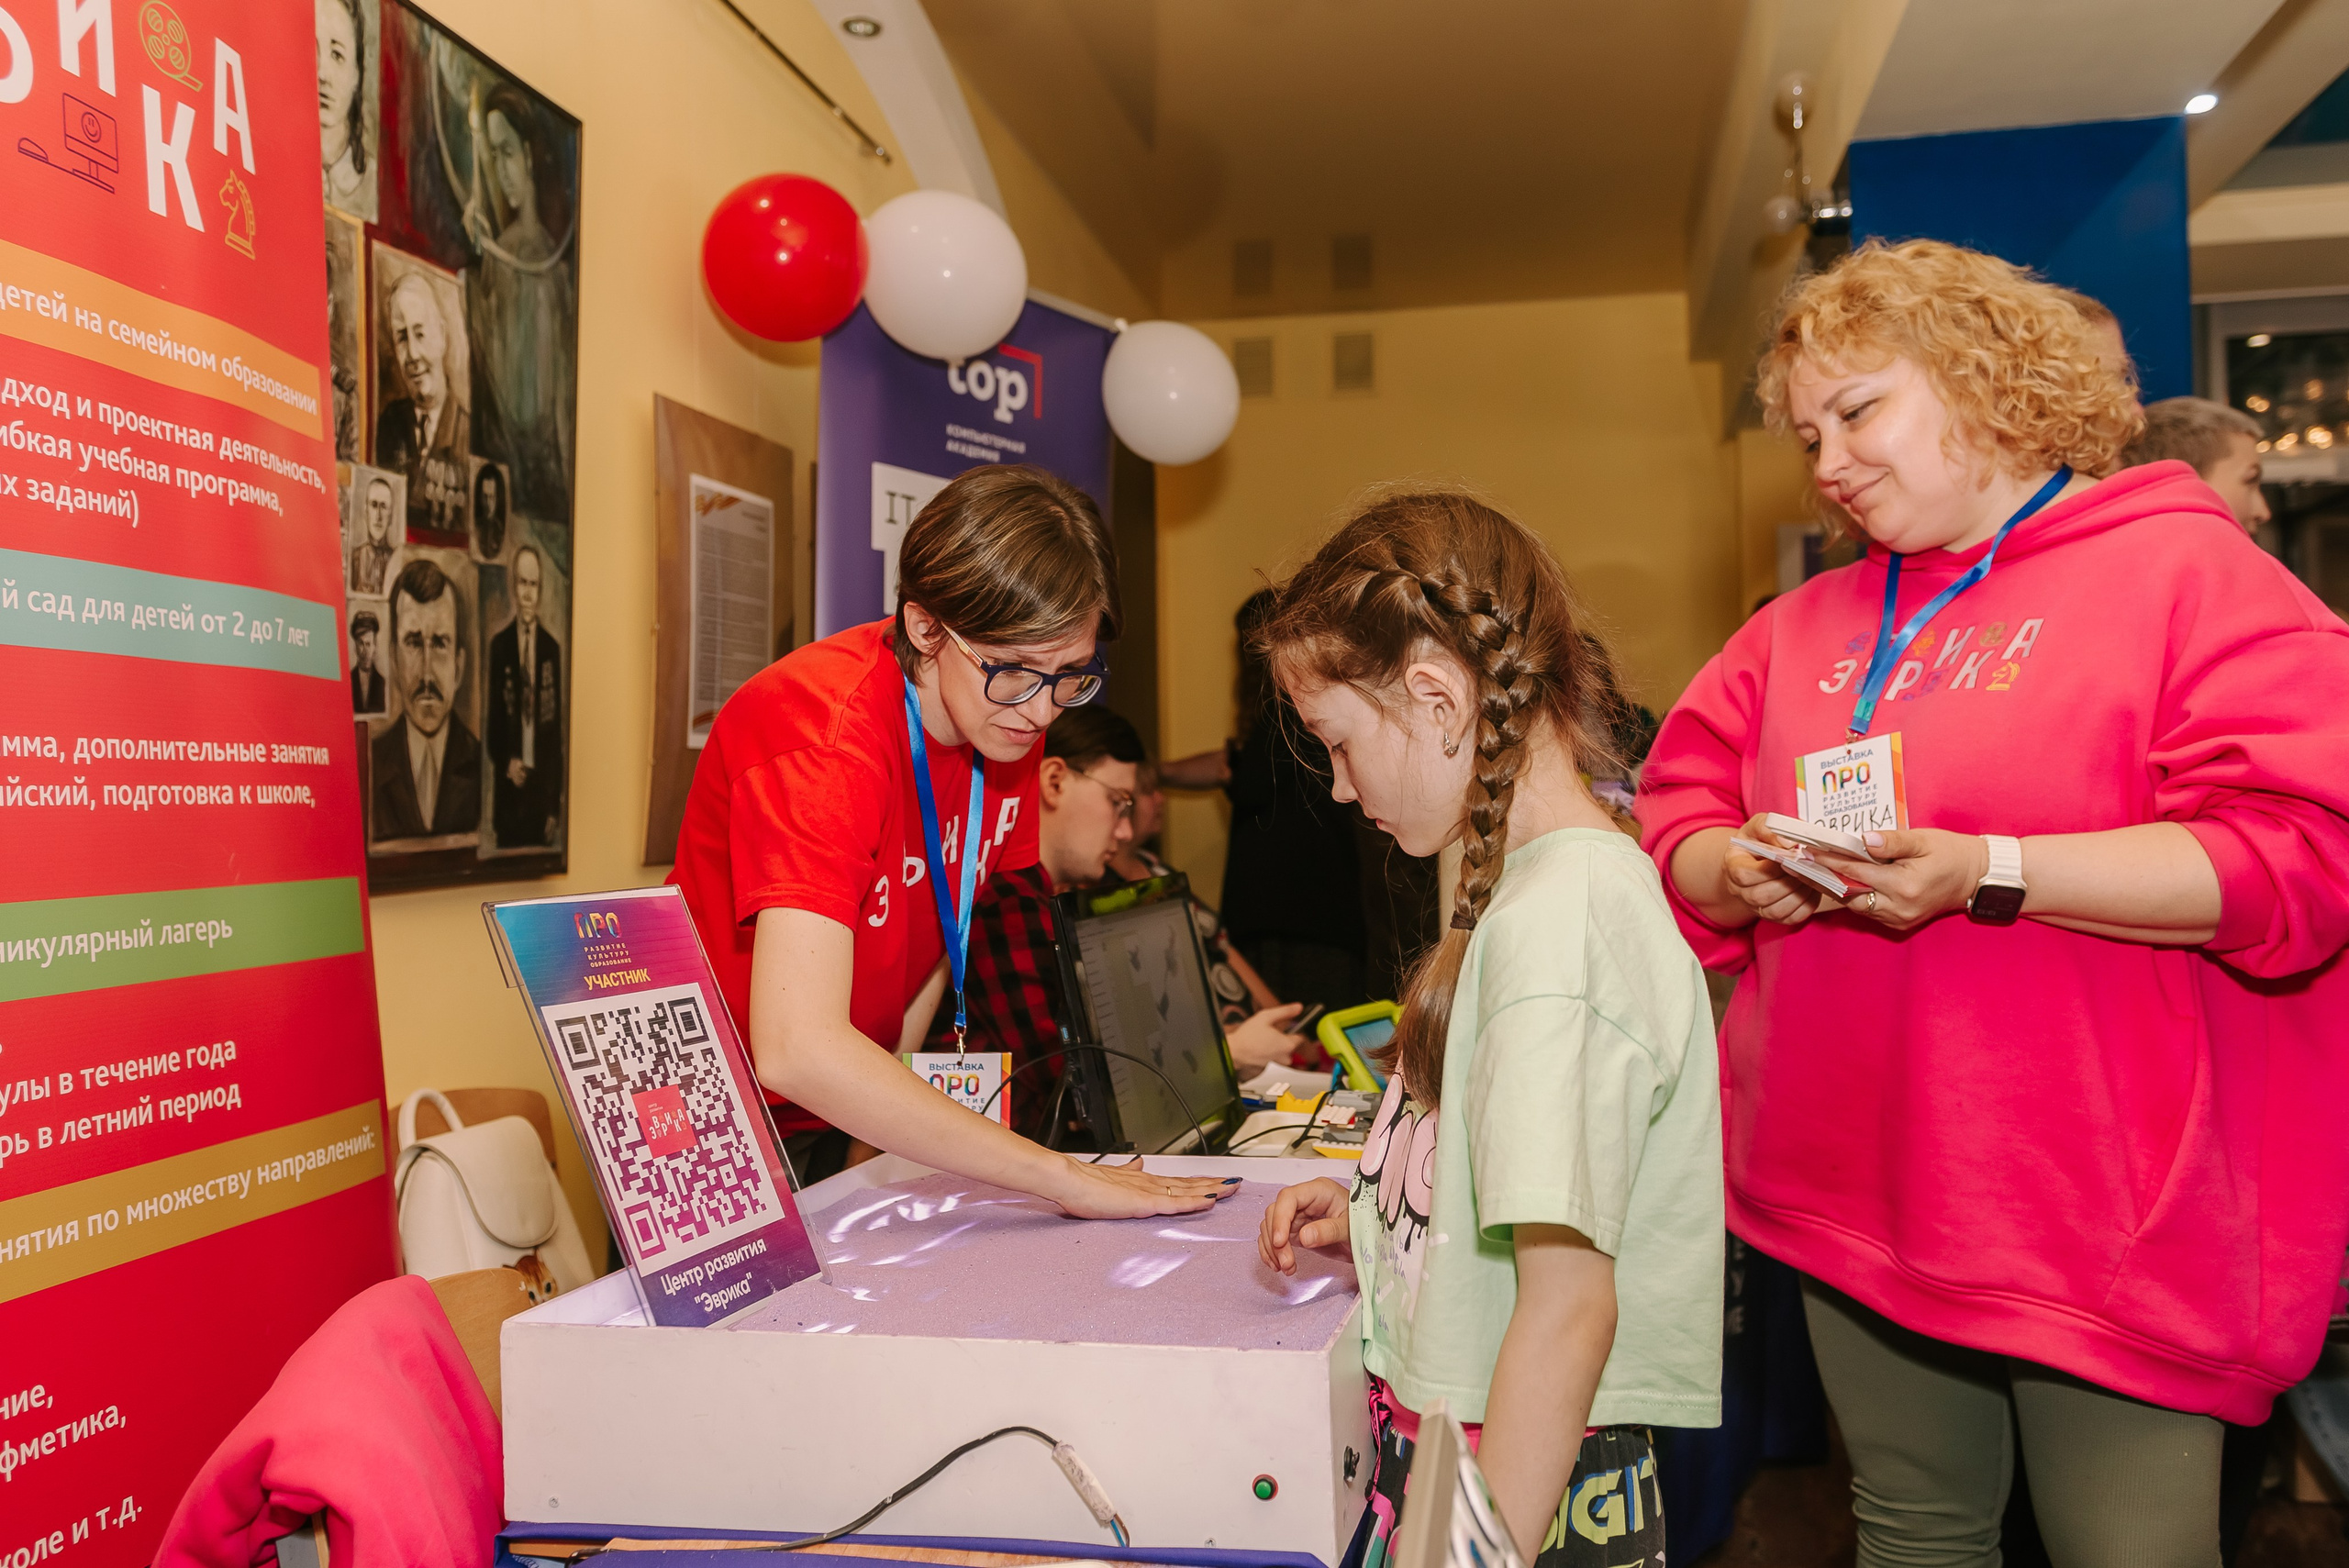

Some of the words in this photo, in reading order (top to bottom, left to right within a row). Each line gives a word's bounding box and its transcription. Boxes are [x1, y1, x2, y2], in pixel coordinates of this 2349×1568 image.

[74, 306, 103, 335] на
[108, 328, 217, 373] семейном
[221, 356, 317, 416] образовании
[1, 377, 71, 420] дход
[77, 395, 92, 419] и
[98, 402, 215, 453] проектная
[218, 437, 327, 495] деятельность,
[26, 479, 139, 528] заданий)
[78, 442, 171, 484] учебная
[176, 467, 284, 517] программа,
[3, 578, 18, 609] й
[28, 590, 75, 622] сад
[82, 598, 126, 625] для
[132, 603, 195, 631] детей
[201, 614, 227, 634] от
[232, 611, 245, 637] 2
[250, 619, 273, 645] до
[275, 617, 284, 641] 7
[287, 627, 310, 647] лет
[1818, 618, 2044, 701] ЭРИКА
[73, 737, 266, 764] дополнительные
[271, 743, 329, 765] занятия
[1820, 749, 1874, 769] ВЫСТАВКА
[104, 784, 234, 812] подготовка
[239, 785, 252, 805] к
[256, 784, 316, 808] школе,
[1822, 762, 1871, 795] ПРО
[1822, 784, 1877, 803] РАЗВИТИЕ
[1823, 798, 1877, 817] ОБРАЗОВАНИЕ
[160, 919, 233, 949] лагерь
[584, 942, 627, 953] РАЗВИТИЕ
[584, 968, 651, 991] УЧАСТНИК
[590, 958, 632, 968] ОБРАЗОВАНИЕ
[59, 1073, 73, 1095] в
[81, 1051, 181, 1090] течение
[185, 1040, 237, 1071] года
[39, 1126, 53, 1150] в
[61, 1096, 153, 1145] летний
[160, 1083, 242, 1122] период
[87, 1209, 119, 1237] по
[127, 1169, 251, 1226] множеству
[257, 1126, 375, 1185] направлений:
[661, 1266, 704, 1296] Центр
[704, 1239, 767, 1276] развития
[695, 1273, 752, 1312] "Эврика"
[0, 1405, 127, 1483] фметика,
[72, 1517, 89, 1545] и
[95, 1495, 142, 1530] т.д.
